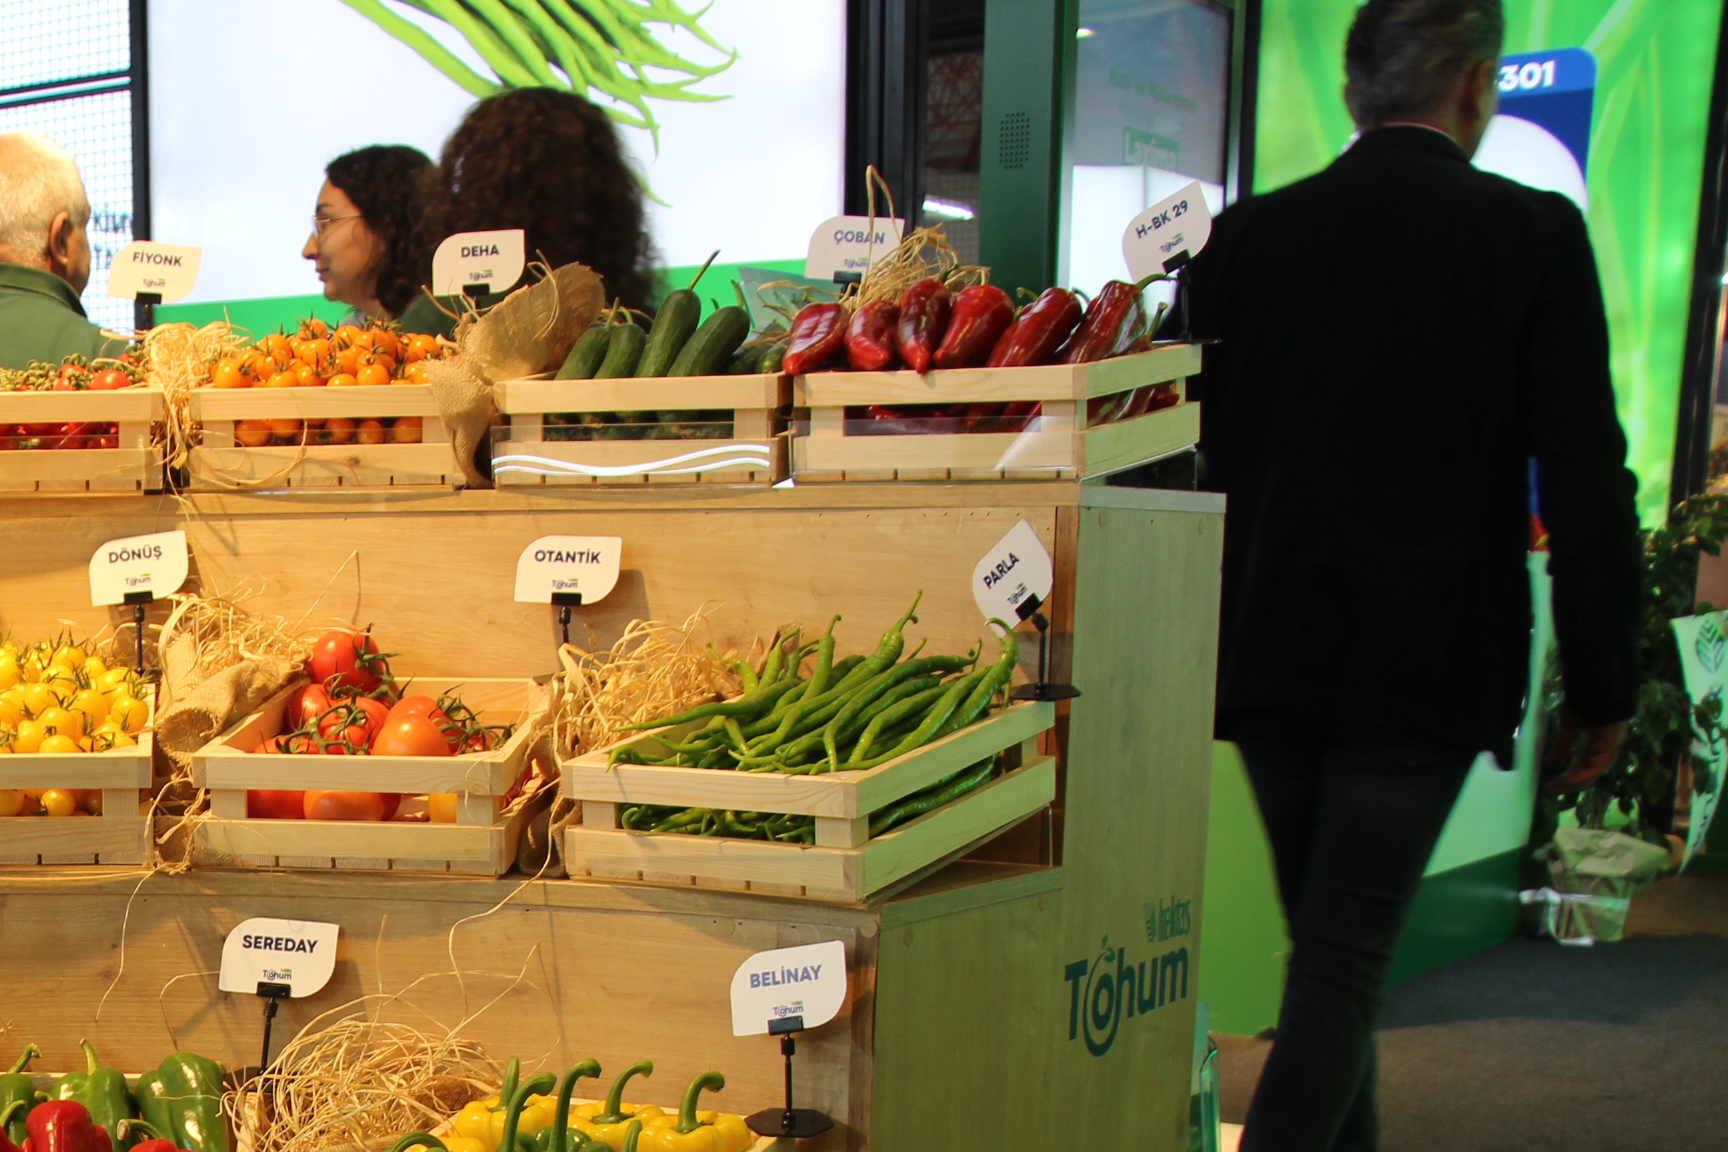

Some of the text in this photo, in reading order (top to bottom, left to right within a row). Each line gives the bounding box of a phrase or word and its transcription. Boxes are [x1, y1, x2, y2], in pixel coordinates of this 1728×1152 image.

[1496, 59, 1556, 93] 301
[1135, 199, 1189, 239] H-BK 29
[834, 229, 885, 245] ÇOBAN
[132, 250, 183, 267] FİYONK
[461, 244, 500, 258] DEHA
[108, 544, 162, 563] DÖNÜŞ
[534, 548, 602, 564] OTANTİK
[982, 552, 1020, 590] PARLA
[242, 934, 319, 954] SEREDAY
[749, 964, 822, 989] BELİNAY
[1065, 944, 1189, 1057] Tohum
